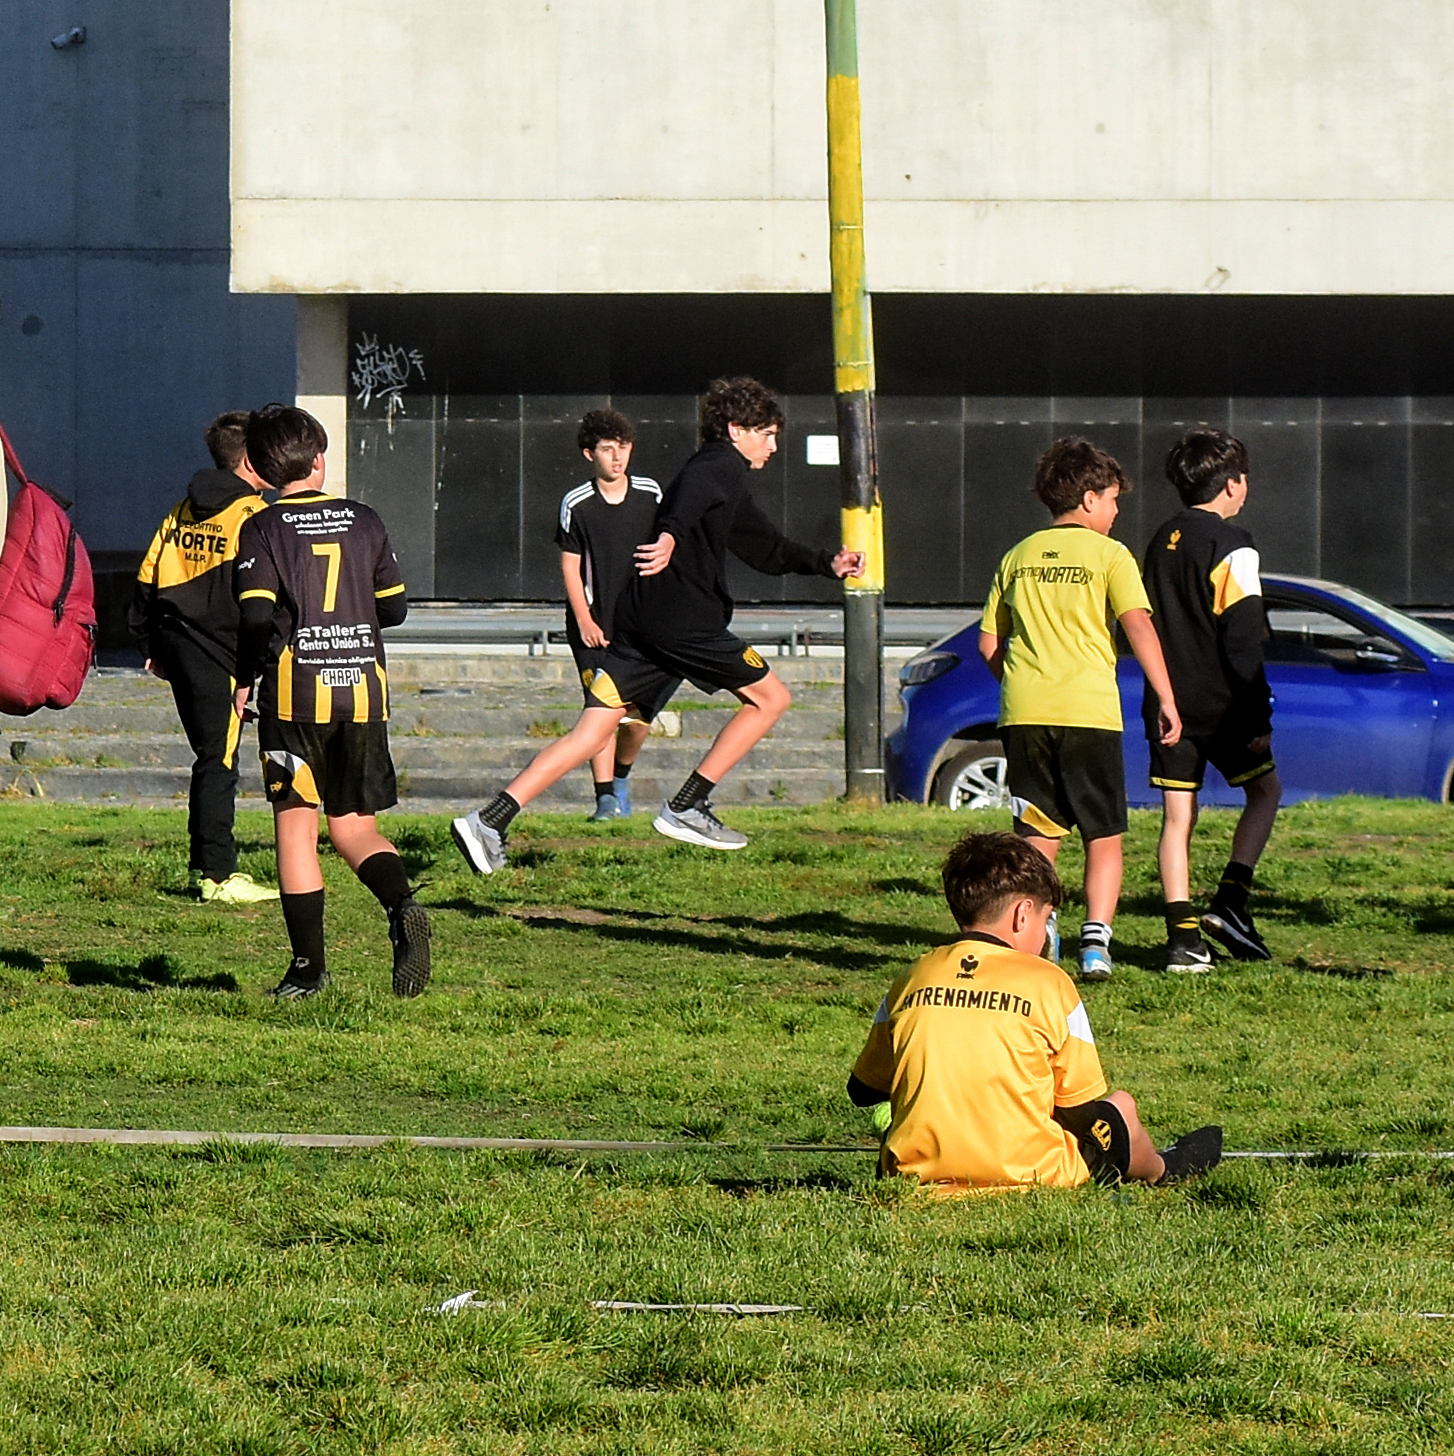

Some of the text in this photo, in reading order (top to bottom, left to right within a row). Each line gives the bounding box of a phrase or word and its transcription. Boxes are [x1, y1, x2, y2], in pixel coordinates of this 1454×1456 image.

[282, 508, 355, 522] Green Park
[165, 528, 228, 555] NORTE
[311, 543, 341, 612] 7
[311, 625, 356, 638] Taller
[299, 638, 330, 650] Centro
[321, 668, 361, 686] CHAPU
